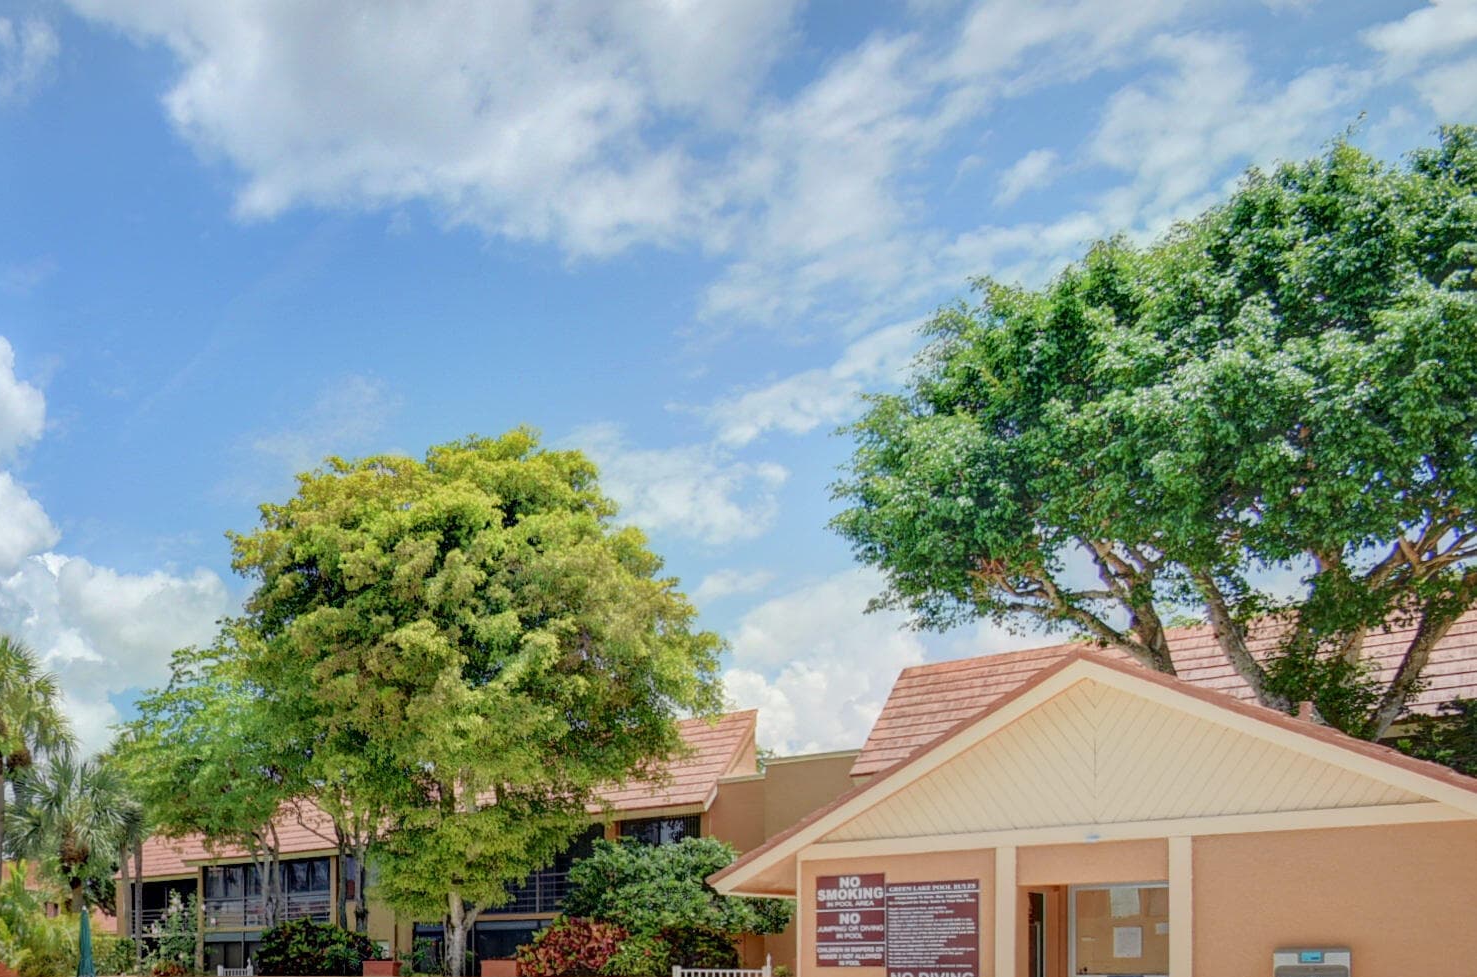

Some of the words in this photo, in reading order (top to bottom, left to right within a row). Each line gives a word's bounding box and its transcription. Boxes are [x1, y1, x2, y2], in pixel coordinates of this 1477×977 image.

[839, 876, 861, 888] NO
[817, 887, 884, 901] SMOKING
[839, 912, 861, 925] NO
